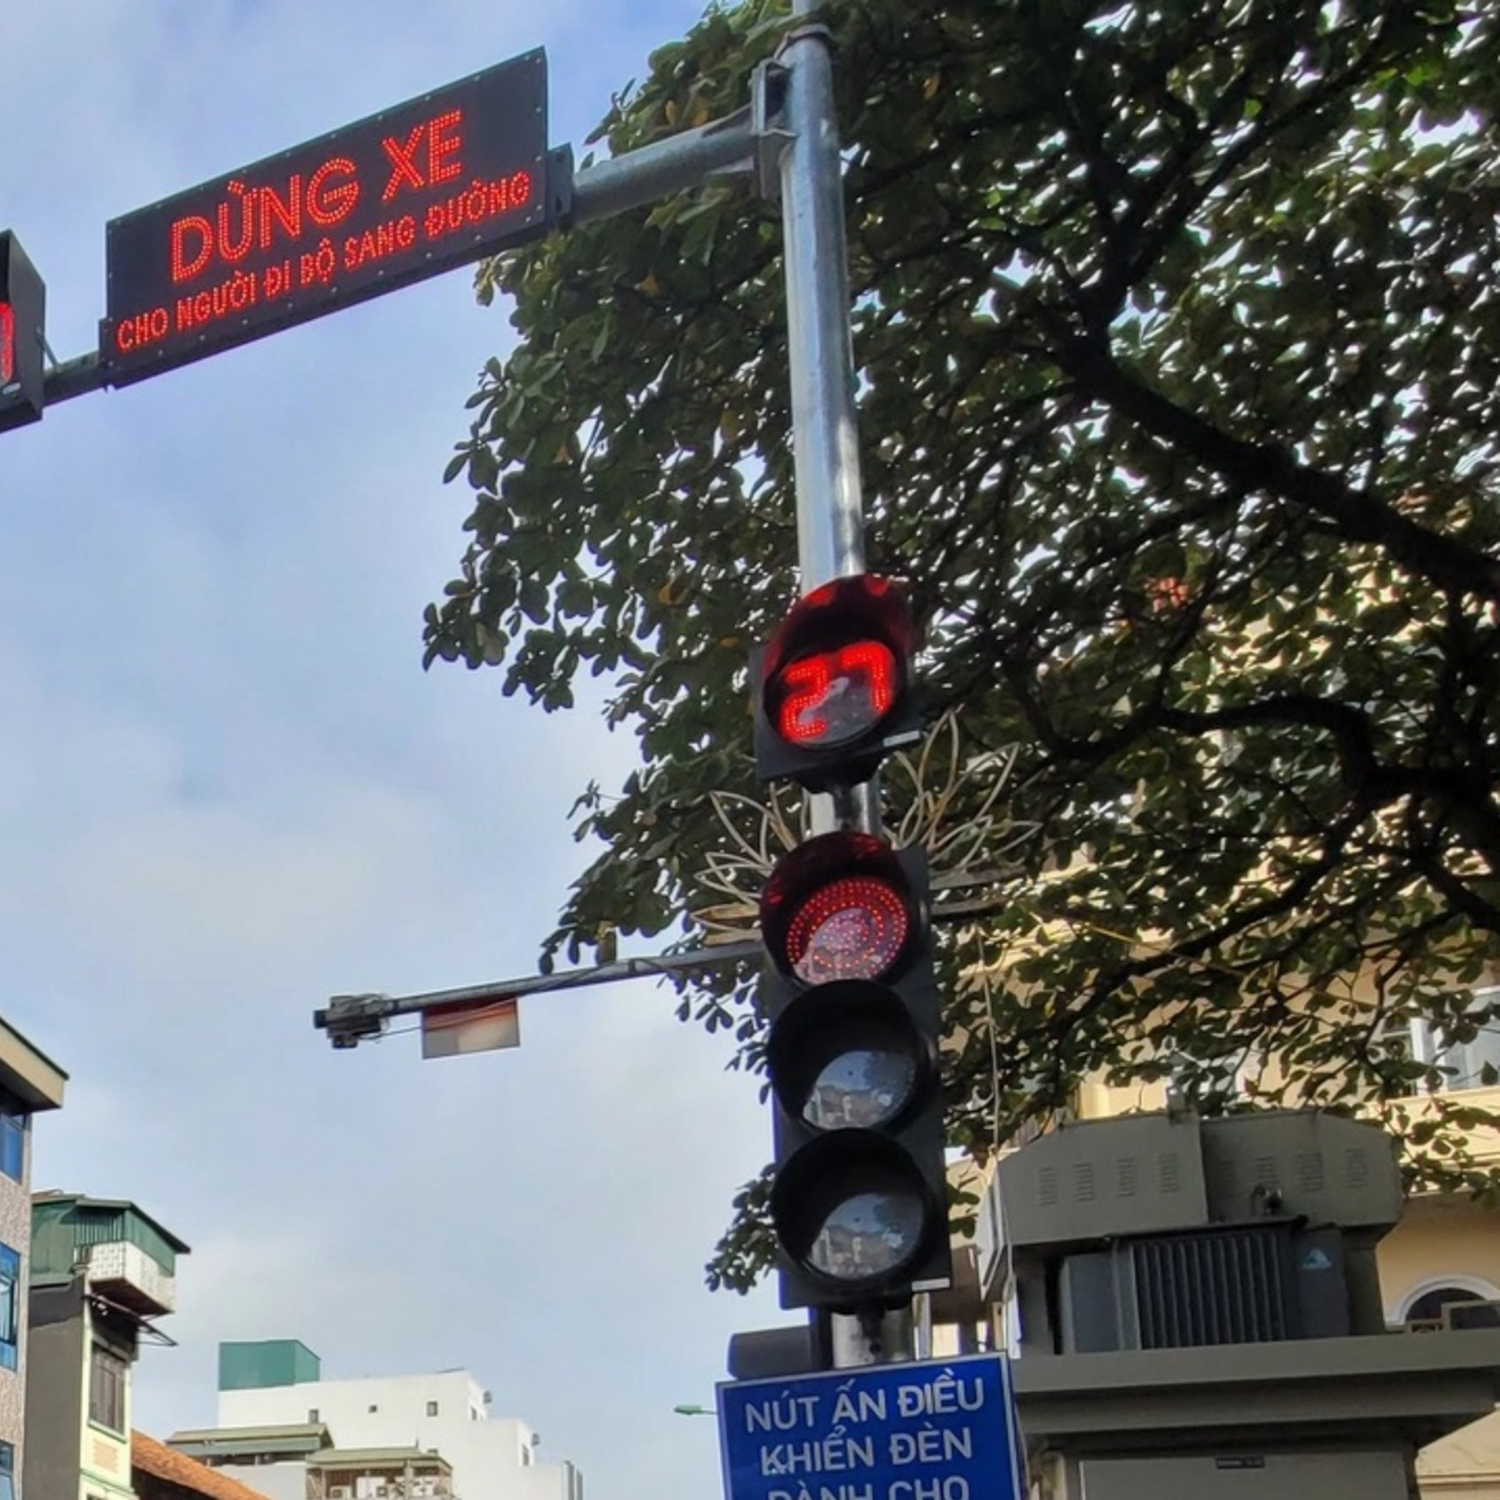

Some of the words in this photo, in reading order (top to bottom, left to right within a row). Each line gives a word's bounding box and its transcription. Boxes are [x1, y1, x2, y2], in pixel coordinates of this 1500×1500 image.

[171, 157, 360, 284] DỪNG
[380, 107, 464, 202] XE
[115, 305, 168, 354] CHO
[175, 271, 257, 332] NGƯỜI
[263, 259, 292, 301] ĐI
[300, 237, 337, 284] BỘ
[343, 214, 417, 270] SANG
[422, 169, 532, 240] ĐƯỜNG
[780, 640, 894, 745] 27
[745, 1389, 819, 1433] NÚT
[832, 1376, 888, 1424] ẤN
[896, 1366, 985, 1418] ĐIỀU
[760, 1424, 874, 1477] KHIỂN
[888, 1421, 973, 1467] ĐÈN
